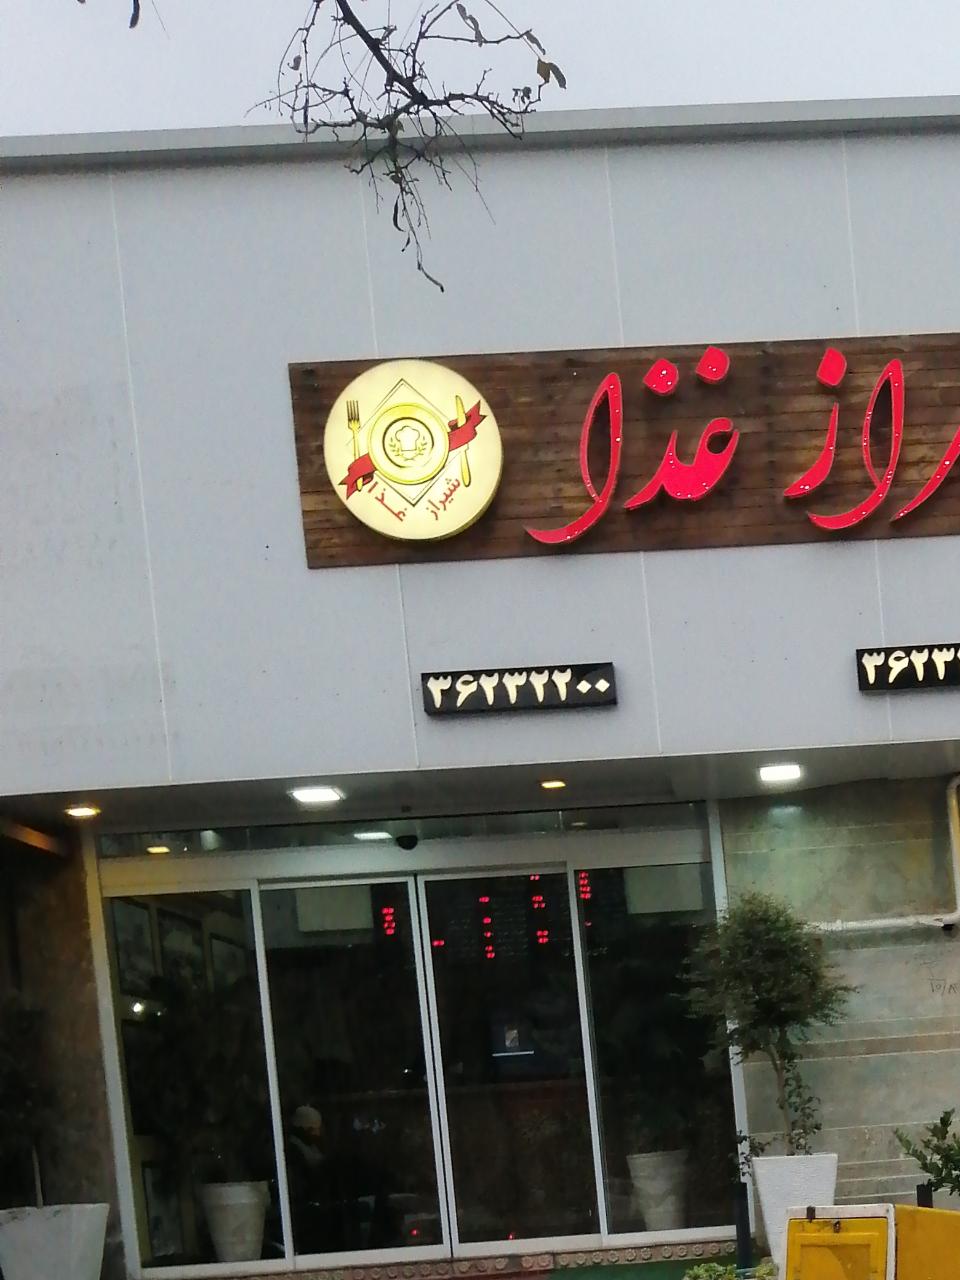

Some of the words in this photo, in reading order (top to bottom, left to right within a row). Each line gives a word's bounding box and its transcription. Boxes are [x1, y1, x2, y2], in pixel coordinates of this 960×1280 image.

[524, 345, 740, 545] غذا
[426, 477, 461, 521] شیراز
[427, 668, 610, 709] ۳۶۲۳۲۲۰۰
